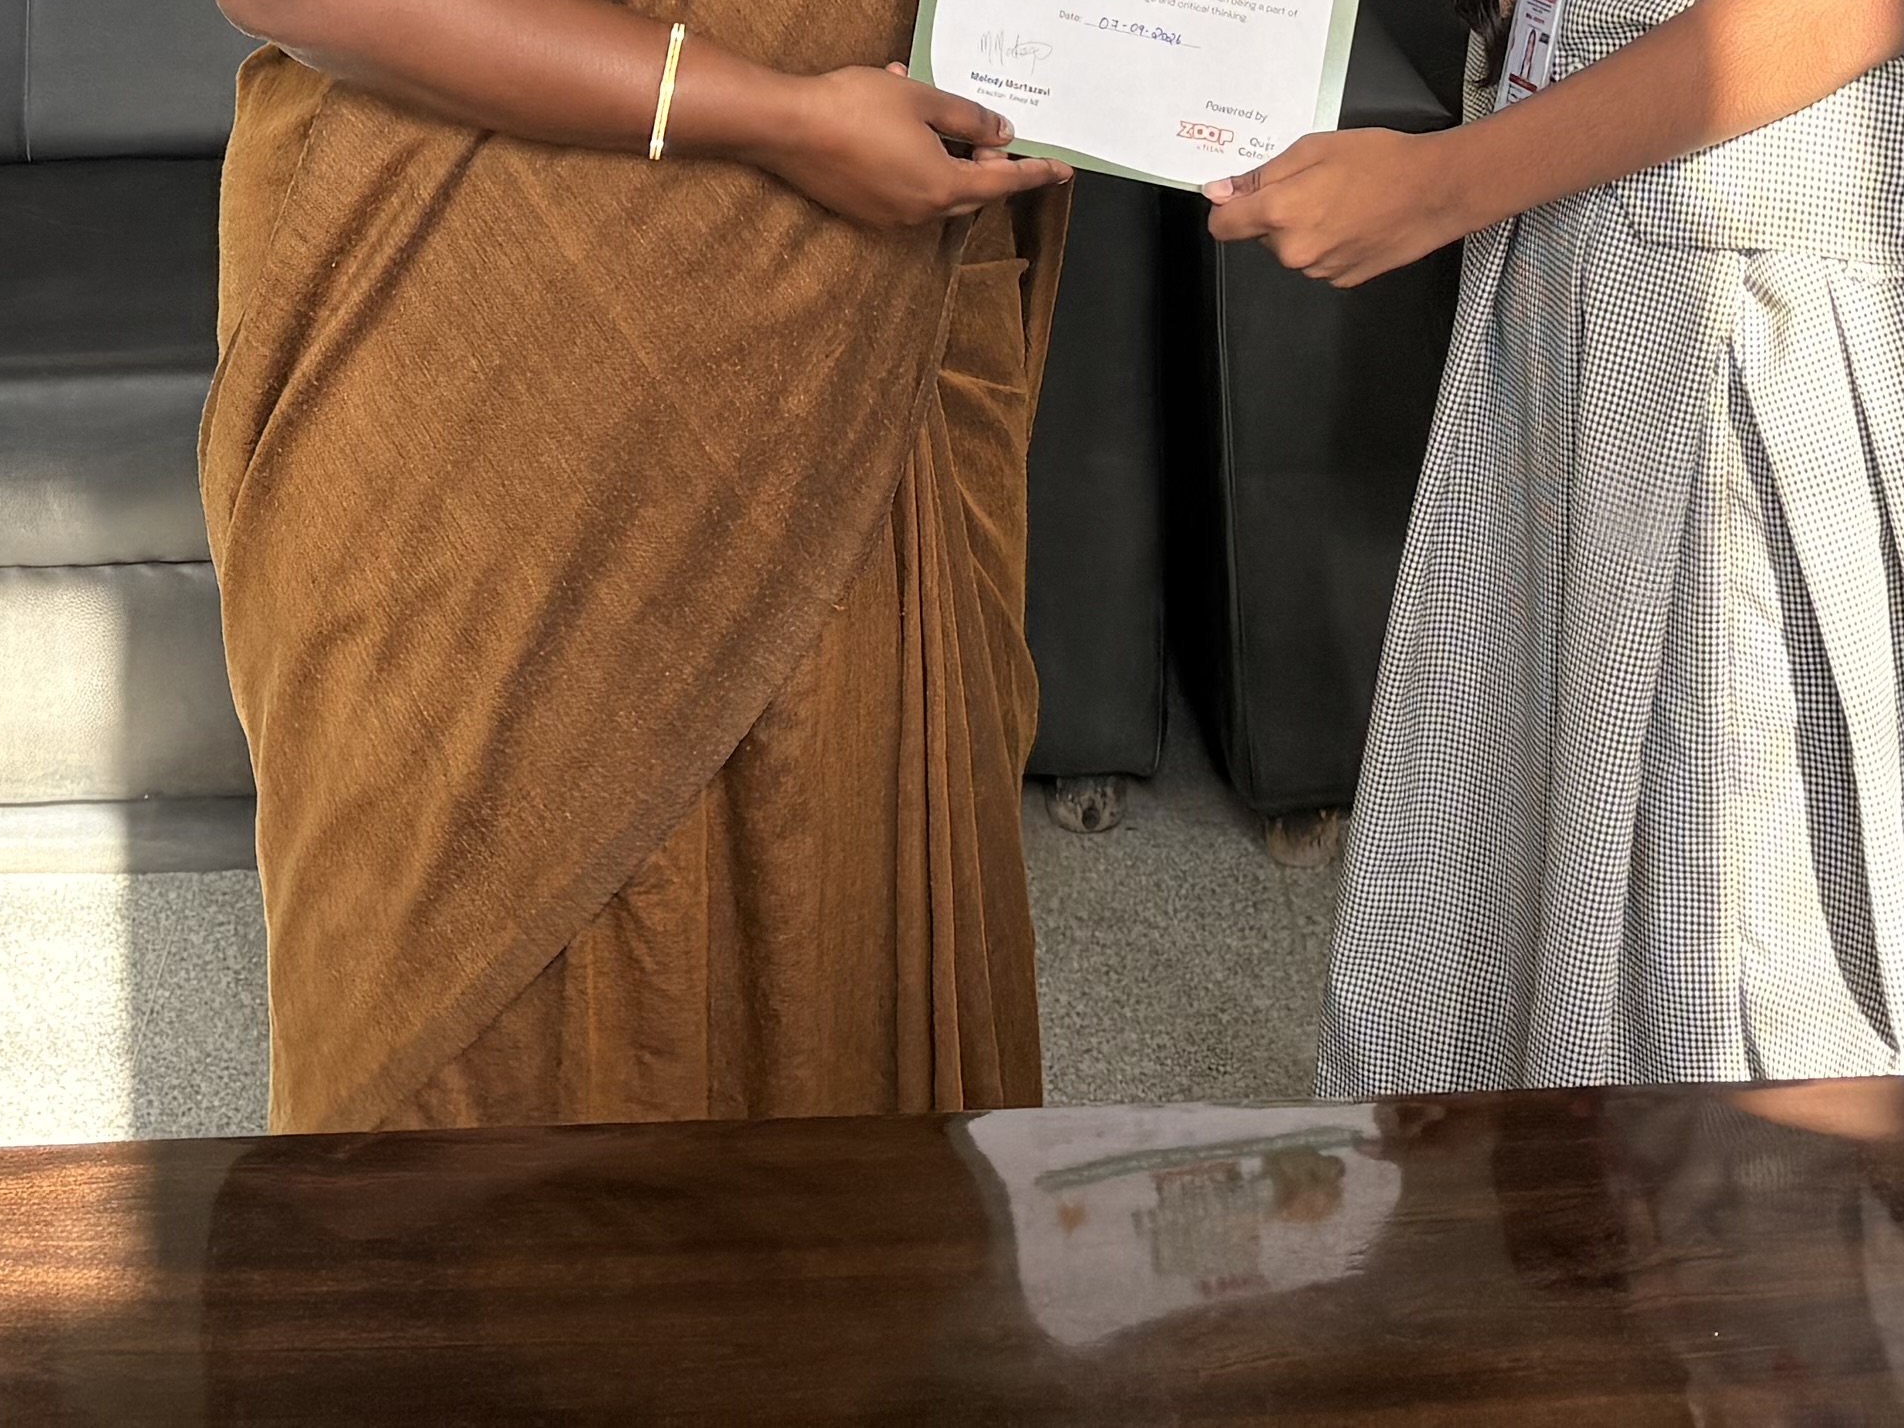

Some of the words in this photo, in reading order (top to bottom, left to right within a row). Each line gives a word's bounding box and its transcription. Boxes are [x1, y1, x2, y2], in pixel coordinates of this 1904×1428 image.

[1178, 0, 1210, 13] critical
[1259, 2, 1265, 10] a
[1266, 2, 1285, 15] part
[1288, 9, 1298, 17] of
[1059, 9, 1082, 22] Date:
[1206, 100, 1254, 119] Powered
[1255, 111, 1268, 123] by
[1176, 120, 1234, 145] ZOOP
